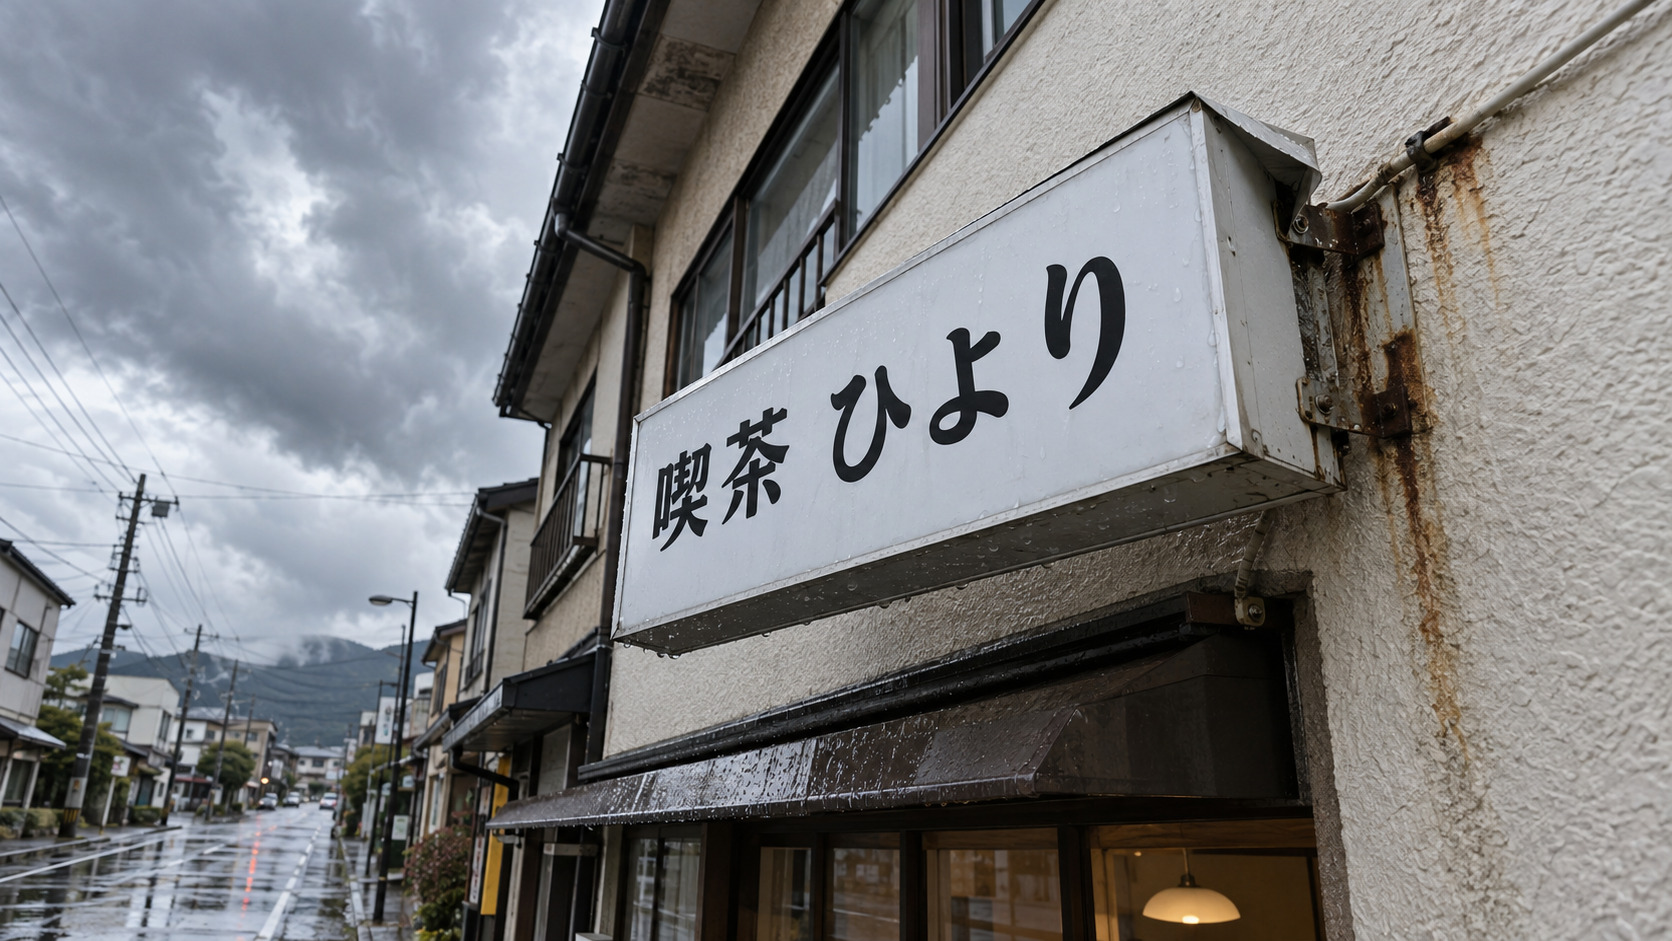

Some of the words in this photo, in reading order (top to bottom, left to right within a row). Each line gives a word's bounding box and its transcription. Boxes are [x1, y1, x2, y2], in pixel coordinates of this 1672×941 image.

[652, 407, 790, 552] 喫茶
[830, 256, 1126, 483] ひより
